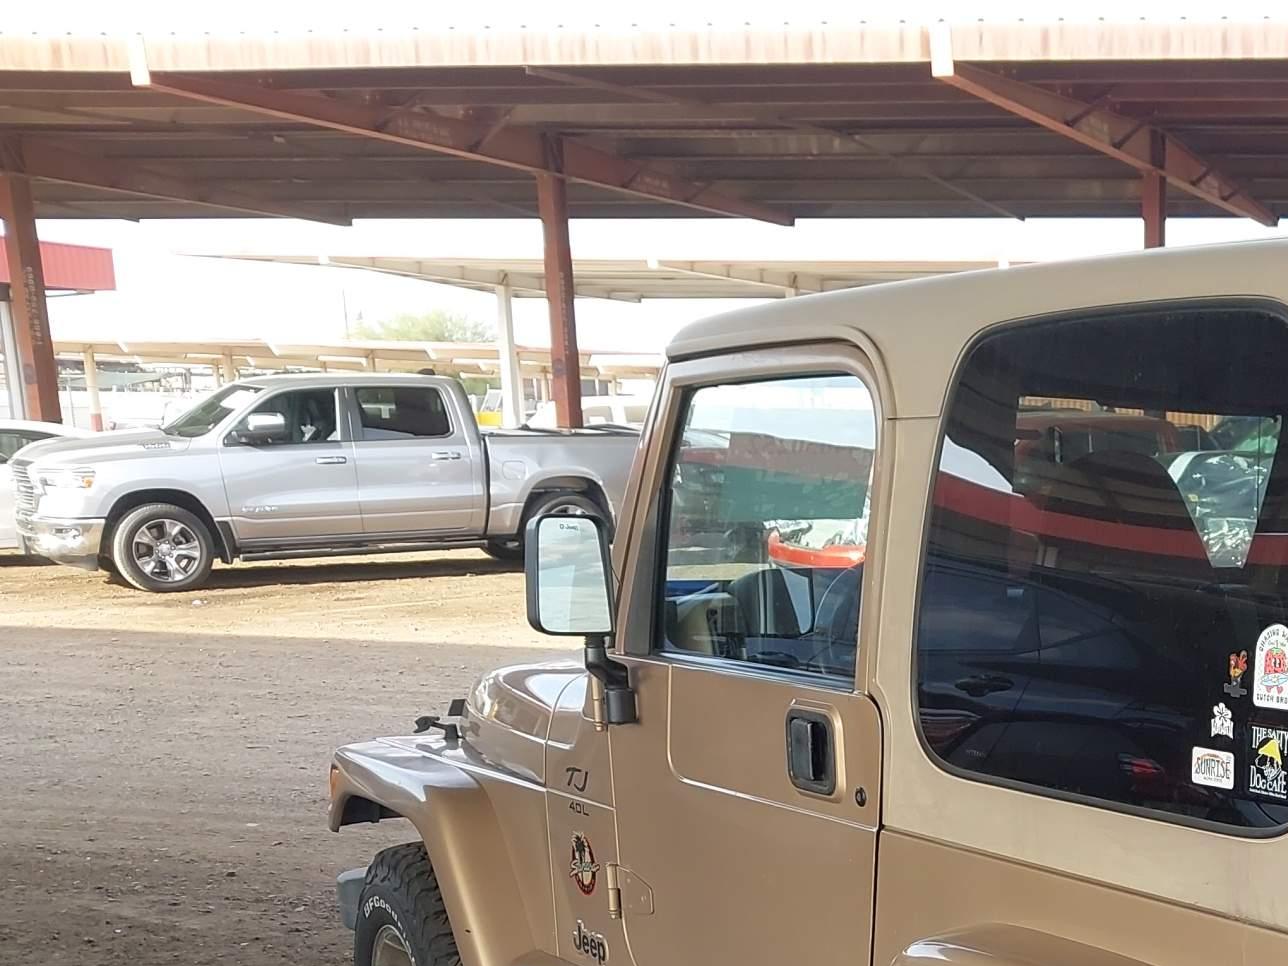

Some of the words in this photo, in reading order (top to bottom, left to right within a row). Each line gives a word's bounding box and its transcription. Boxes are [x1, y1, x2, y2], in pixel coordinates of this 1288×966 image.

[1258, 629, 1280, 652] CHASING
[1251, 725, 1268, 749] THE
[566, 767, 589, 792] TJ
[1195, 757, 1231, 780] SUNRISE
[1249, 765, 1267, 790] DOG
[1266, 770, 1288, 794] CAFE
[573, 920, 609, 966] Jeep
